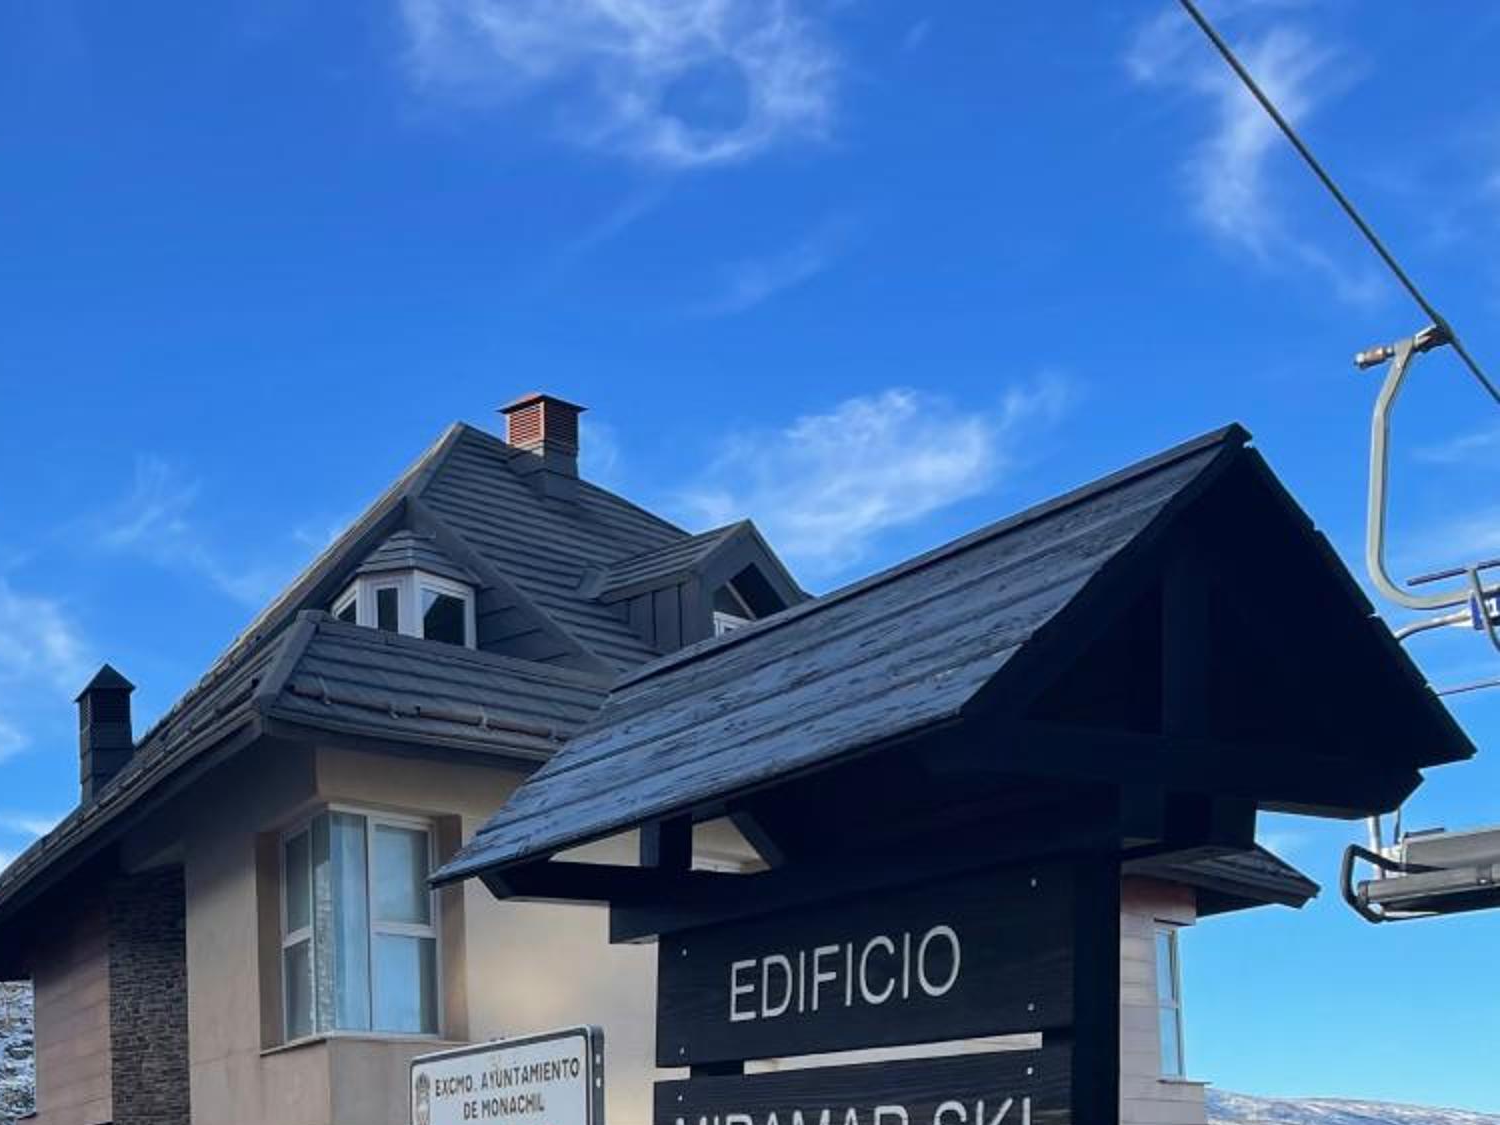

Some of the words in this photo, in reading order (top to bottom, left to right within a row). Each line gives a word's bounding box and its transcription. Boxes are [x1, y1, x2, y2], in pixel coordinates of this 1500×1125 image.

[729, 925, 961, 1022] EDIFICIO
[435, 1074, 478, 1097] EXCMO.
[481, 1057, 580, 1089] AYUNTAMIENTO
[463, 1101, 478, 1120] DE
[481, 1092, 545, 1118] MONACHIL
